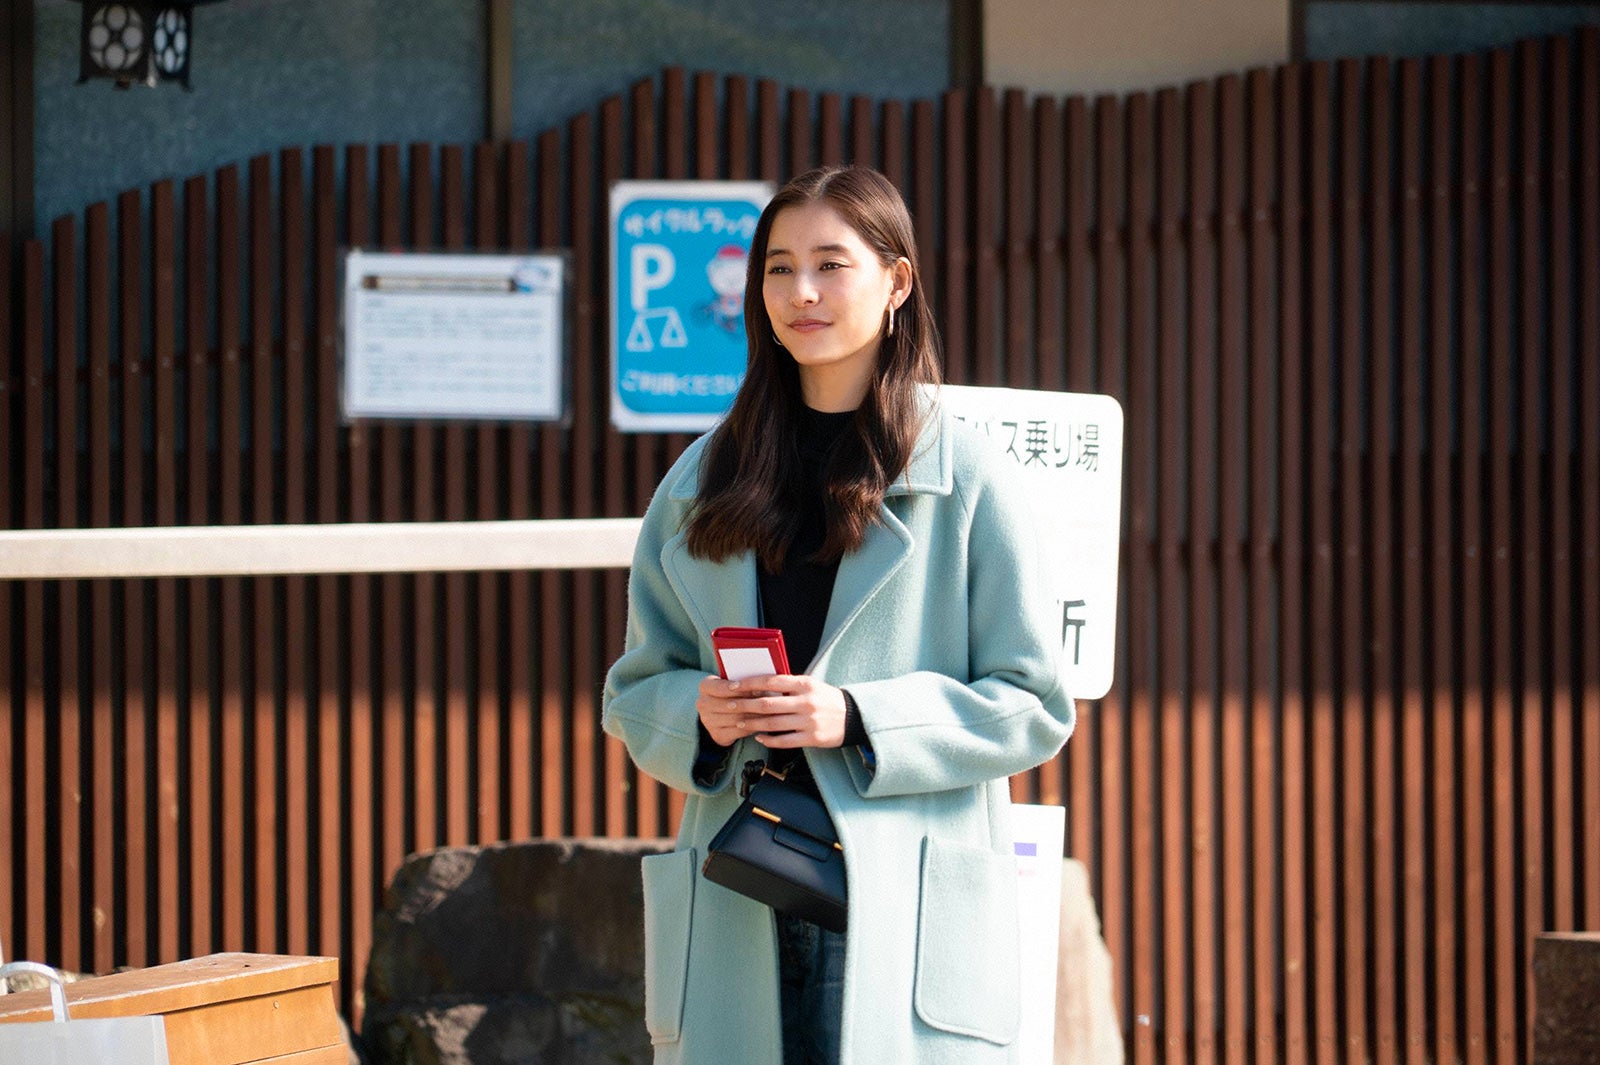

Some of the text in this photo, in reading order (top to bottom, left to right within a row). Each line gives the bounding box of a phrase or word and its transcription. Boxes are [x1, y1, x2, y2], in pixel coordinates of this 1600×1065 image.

[631, 243, 677, 312] P
[953, 415, 1100, 472] ス乗り場
